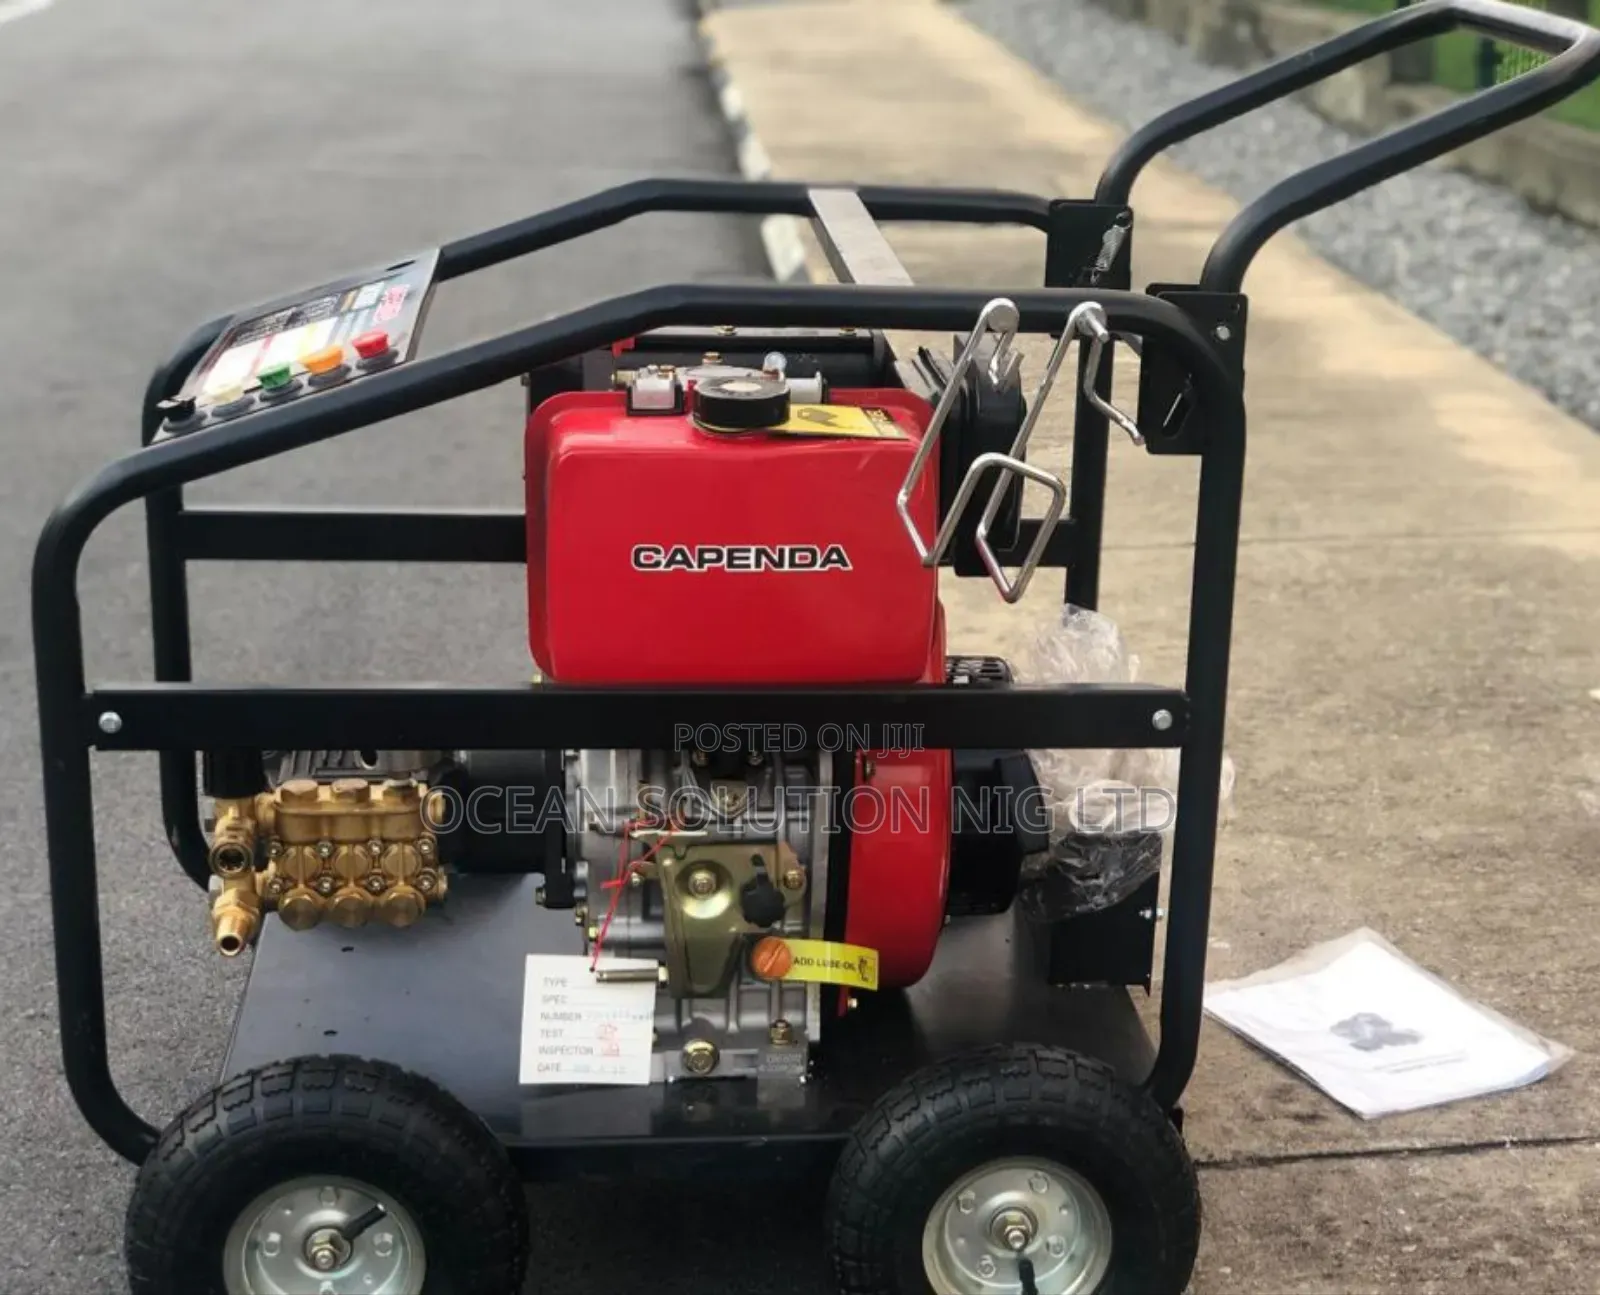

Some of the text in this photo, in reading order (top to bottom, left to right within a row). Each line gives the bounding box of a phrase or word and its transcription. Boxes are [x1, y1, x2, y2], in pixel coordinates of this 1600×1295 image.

[632, 544, 853, 572] CAPENDA
[793, 955, 814, 967] ADD
[542, 976, 569, 988] TYPE
[541, 993, 568, 1004] SPEC
[540, 1011, 583, 1021] NUMBER
[539, 1028, 565, 1039] TEST
[537, 1045, 594, 1056] INSPECTOR
[536, 1061, 561, 1073] DATE
